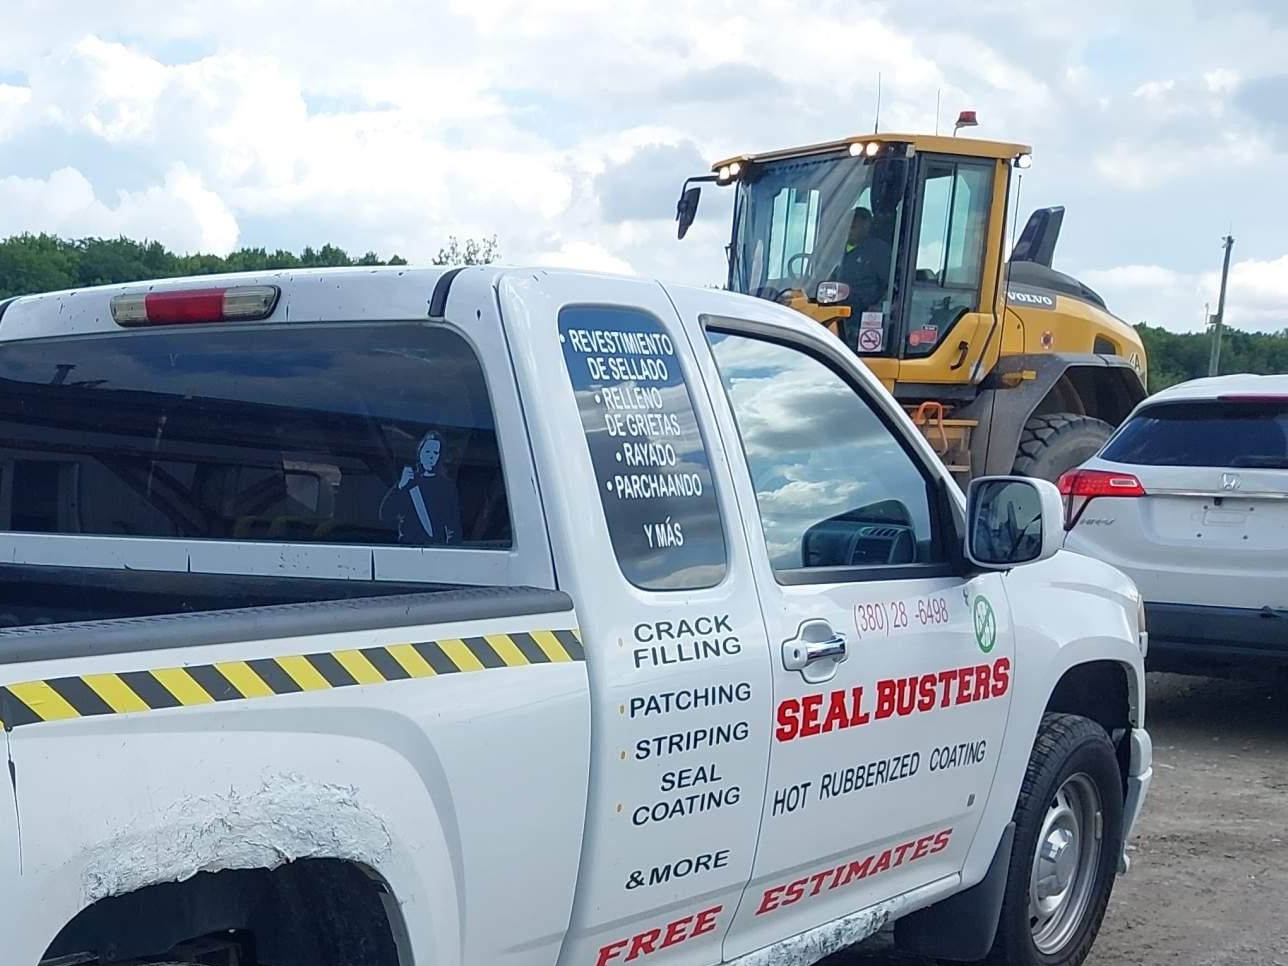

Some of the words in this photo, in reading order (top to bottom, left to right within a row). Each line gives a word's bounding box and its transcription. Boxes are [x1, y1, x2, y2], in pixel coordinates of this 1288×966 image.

[1005, 291, 1053, 305] VOLVO
[568, 329, 674, 355] REVESTIMIENTO
[587, 358, 611, 380] DE
[611, 358, 668, 381] SELLADO
[603, 387, 663, 410] RELLENO
[604, 414, 626, 437] DE
[626, 413, 681, 436] GRIETAS
[623, 443, 677, 467] RAYADO
[614, 473, 703, 499] PARCHAANDO
[643, 523, 655, 548] Y
[656, 516, 684, 548] MÁS
[915, 598, 949, 625] -6498
[633, 614, 735, 643] CRACK
[633, 636, 742, 668] FILLING
[629, 682, 752, 719] PATCHING
[775, 687, 871, 743] SEAL
[873, 656, 1011, 719] BUSTERS
[634, 721, 750, 760] STRIPING
[659, 763, 723, 792] SEAL
[772, 783, 811, 817] HOT
[819, 752, 920, 800] RUBBERIZED
[929, 740, 987, 772] COATING
[631, 786, 741, 826] COATING
[755, 828, 954, 916] ESTIMATES
